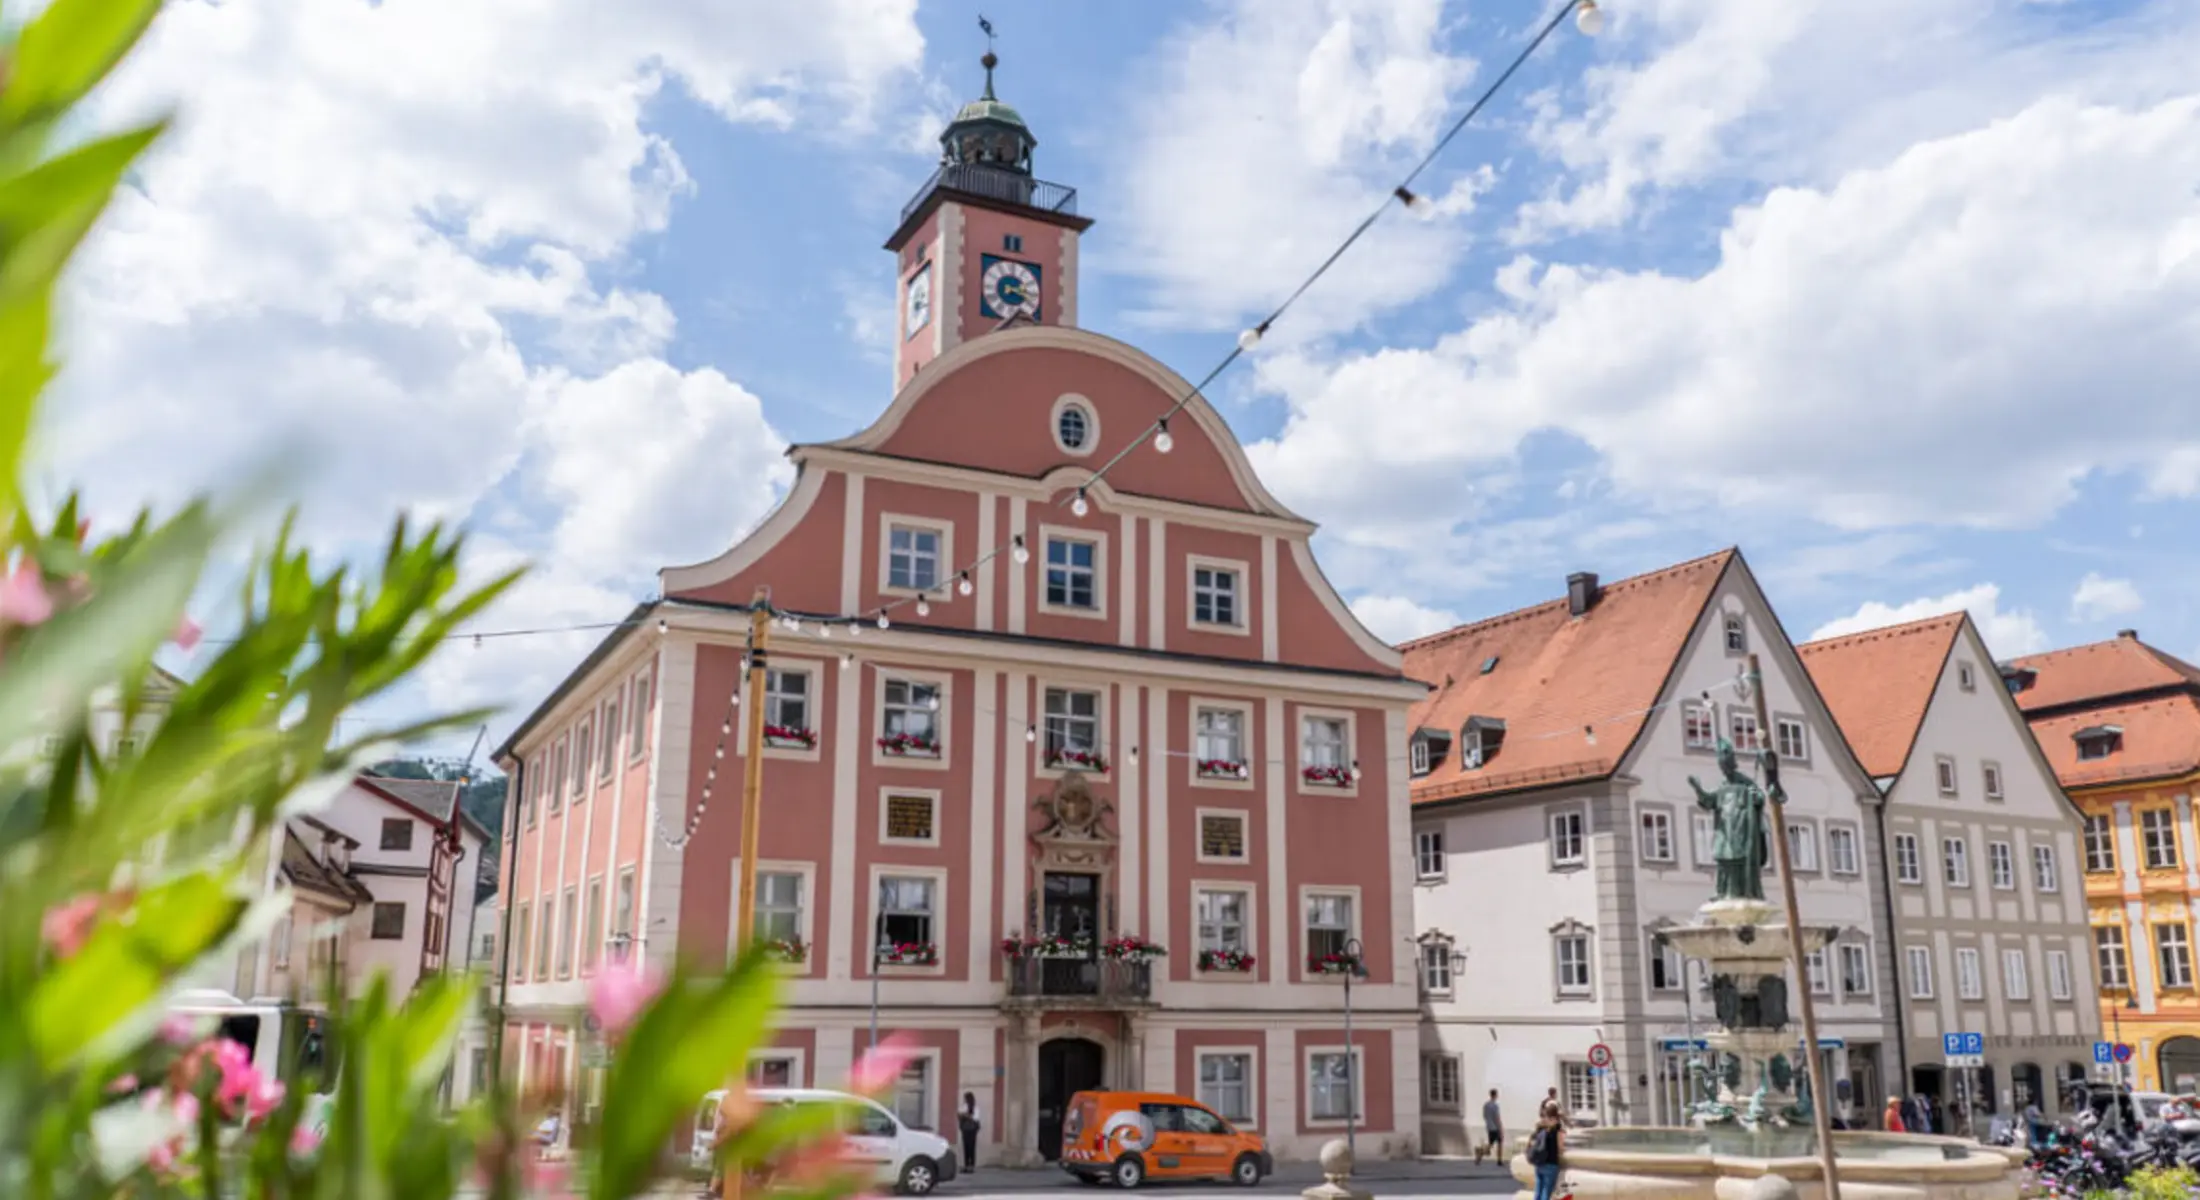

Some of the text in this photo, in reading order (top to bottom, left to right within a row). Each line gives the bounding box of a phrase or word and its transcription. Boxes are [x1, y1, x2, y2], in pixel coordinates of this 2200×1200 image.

[1948, 1034, 1960, 1052] P
[1967, 1034, 1979, 1052] P
[2097, 1044, 2108, 1060] P
